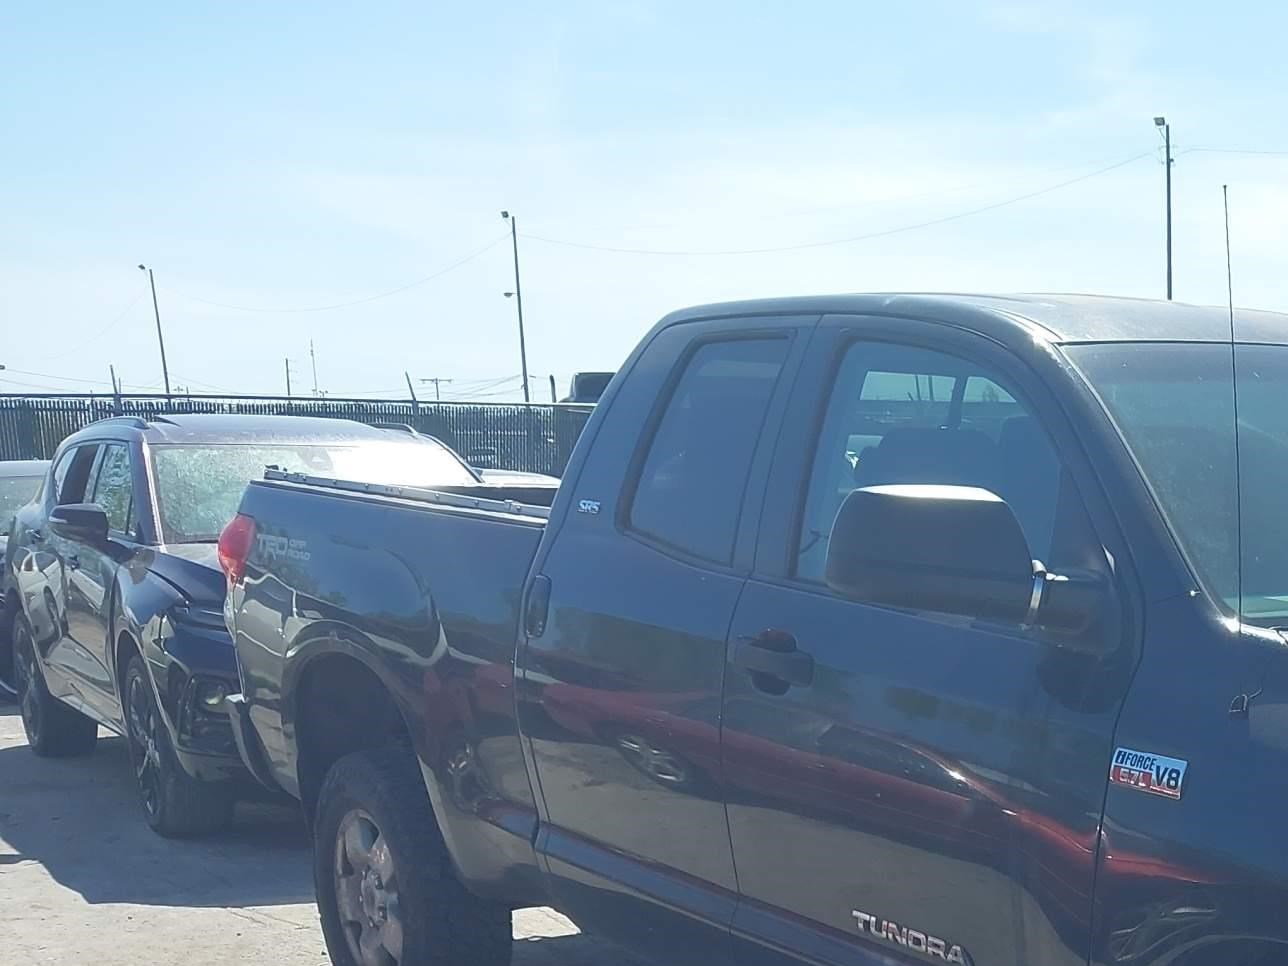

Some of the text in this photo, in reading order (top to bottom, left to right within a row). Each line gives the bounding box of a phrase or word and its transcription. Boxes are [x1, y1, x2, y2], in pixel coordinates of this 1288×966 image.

[578, 500, 601, 514] SR5
[257, 534, 288, 560] TRD
[1155, 765, 1181, 790] V8
[851, 910, 973, 966] TUNDRA
